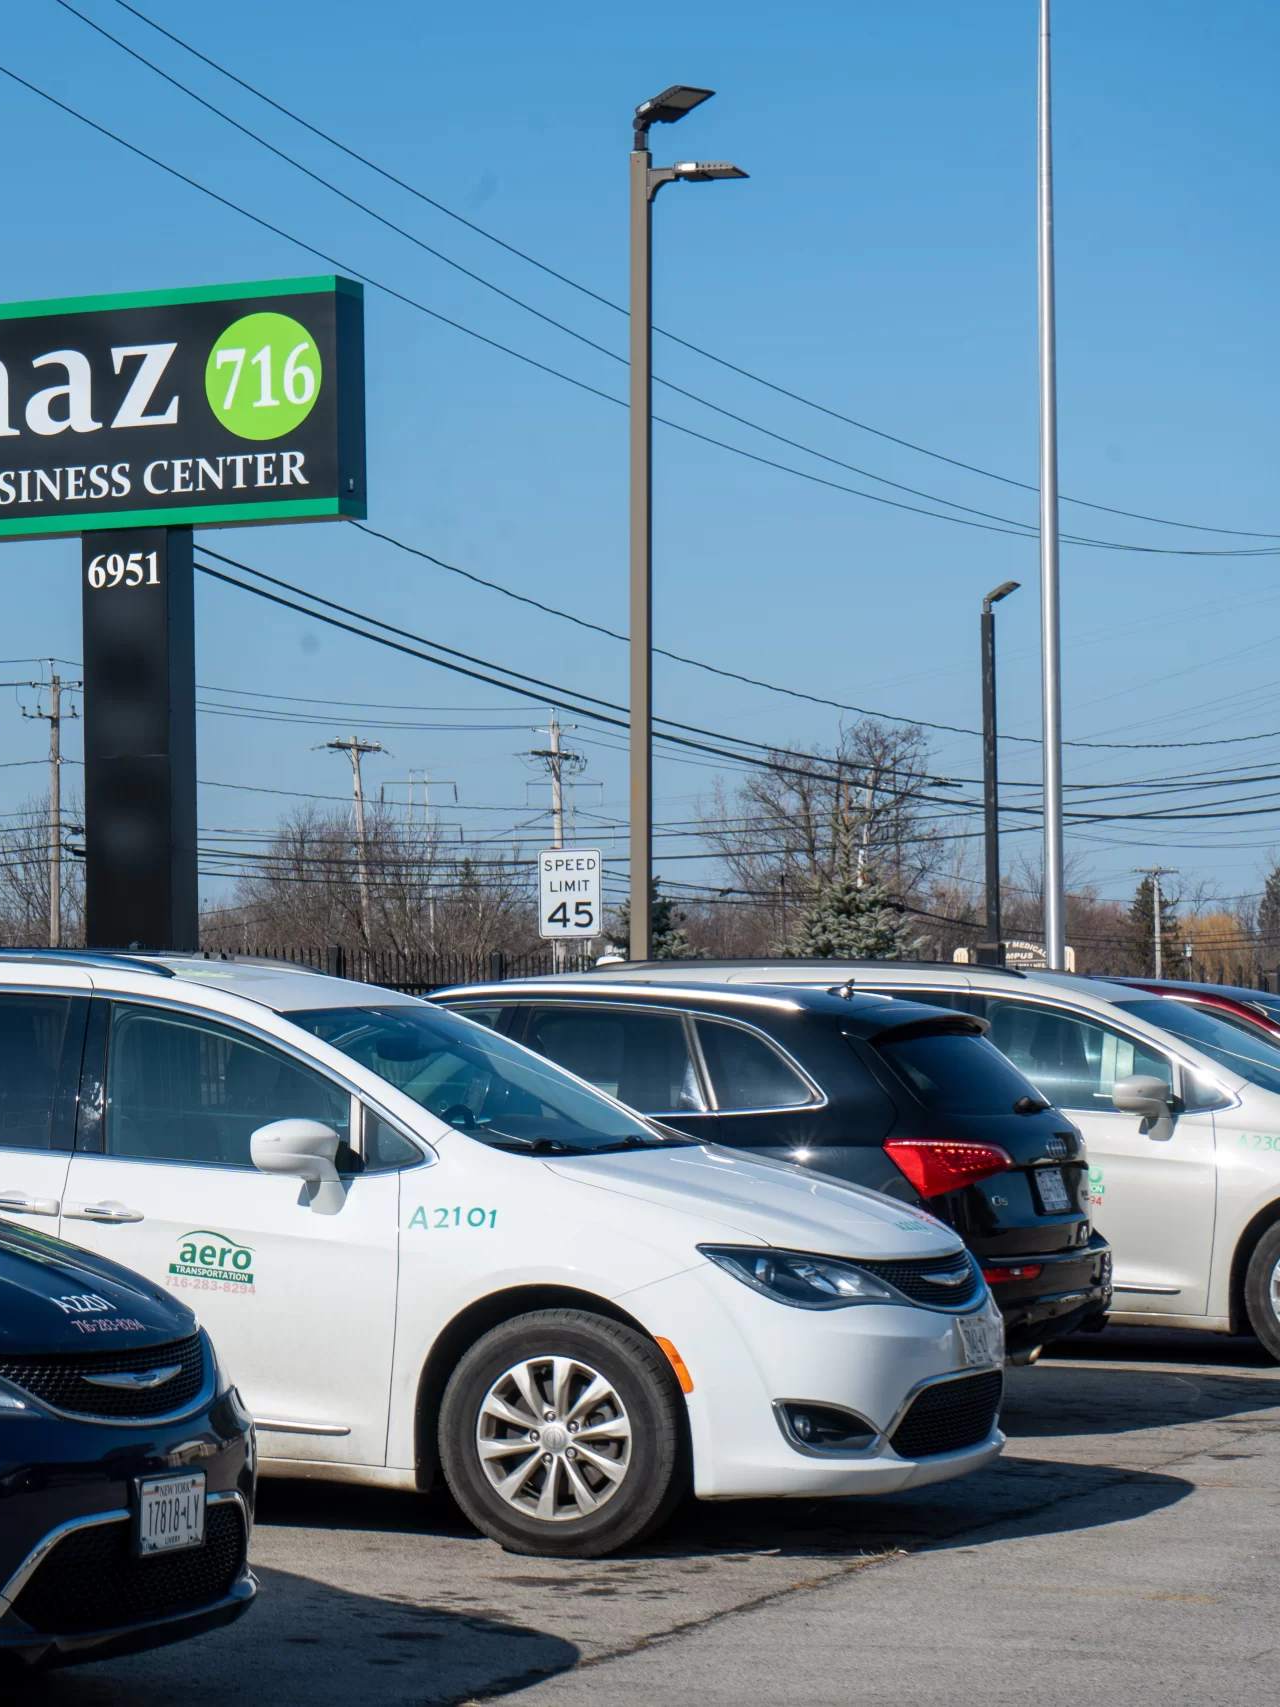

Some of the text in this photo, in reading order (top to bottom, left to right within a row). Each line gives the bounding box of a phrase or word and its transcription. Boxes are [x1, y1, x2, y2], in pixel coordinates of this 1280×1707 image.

[216, 341, 316, 410] 716
[143, 450, 310, 494] CENTER
[87, 551, 161, 588] 6951
[544, 858, 596, 872] SPEED
[549, 879, 590, 893] LIMIT
[547, 901, 594, 929] 45
[1006, 952, 1034, 960] MPUS
[1012, 941, 1046, 957] MEDICAL
[407, 1205, 498, 1230] A2101
[179, 1242, 252, 1270] aero
[175, 1264, 249, 1282] TRANSPORTATION
[165, 1275, 257, 1296] 716-283-8294
[49, 1293, 118, 1314] A2201
[160, 1482, 191, 1497] NEW YORK
